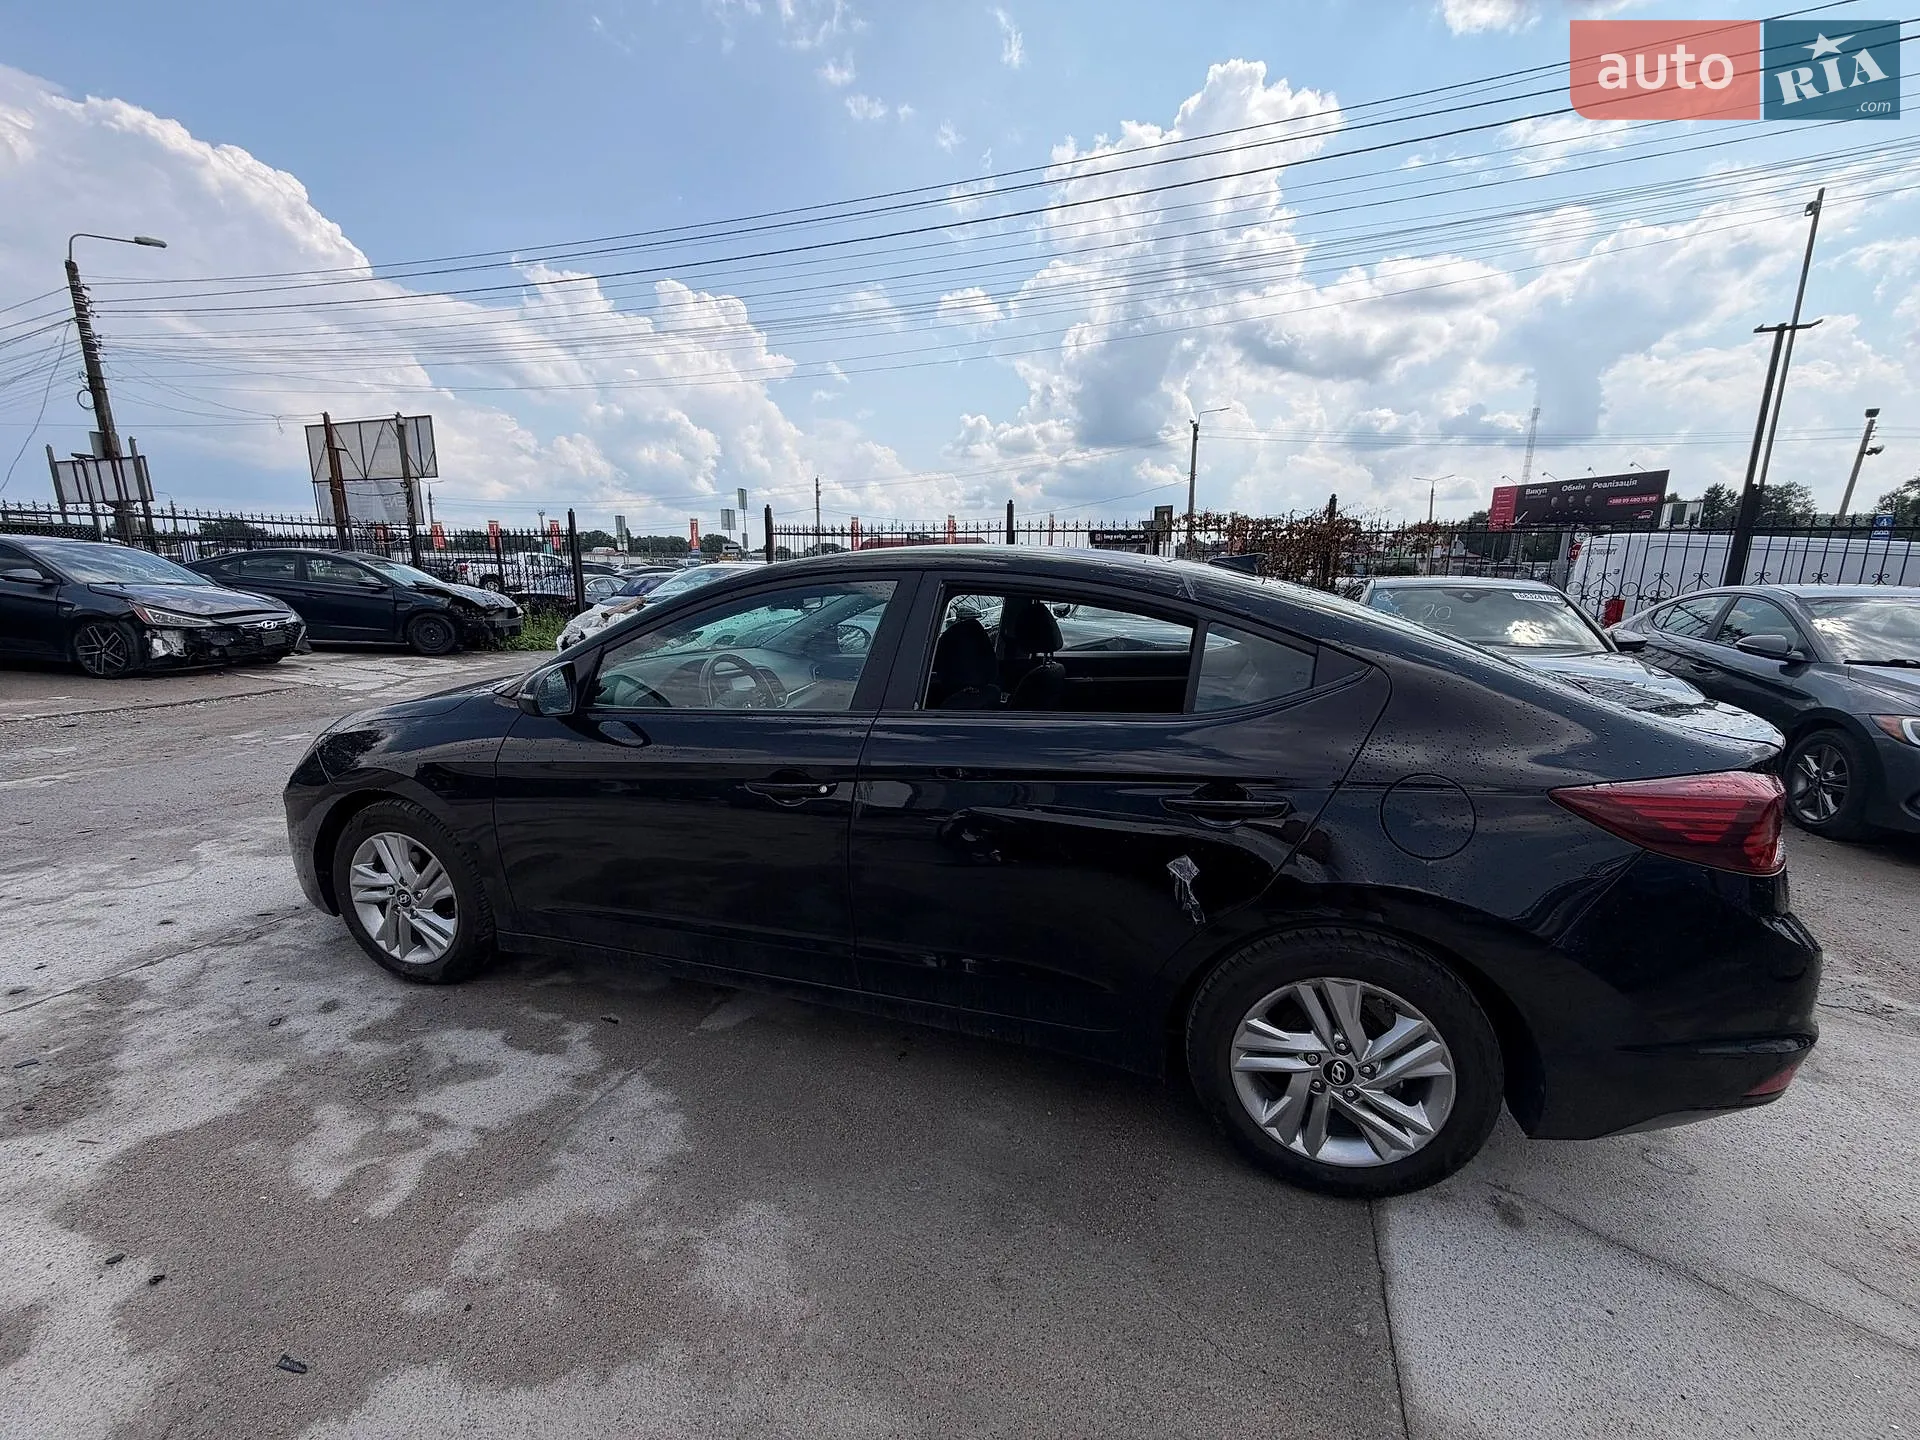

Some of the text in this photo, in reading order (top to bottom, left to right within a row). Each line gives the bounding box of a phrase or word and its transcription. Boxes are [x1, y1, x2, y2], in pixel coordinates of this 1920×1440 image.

[1525, 478, 1638, 496] Викуп Обмін Реалізація
